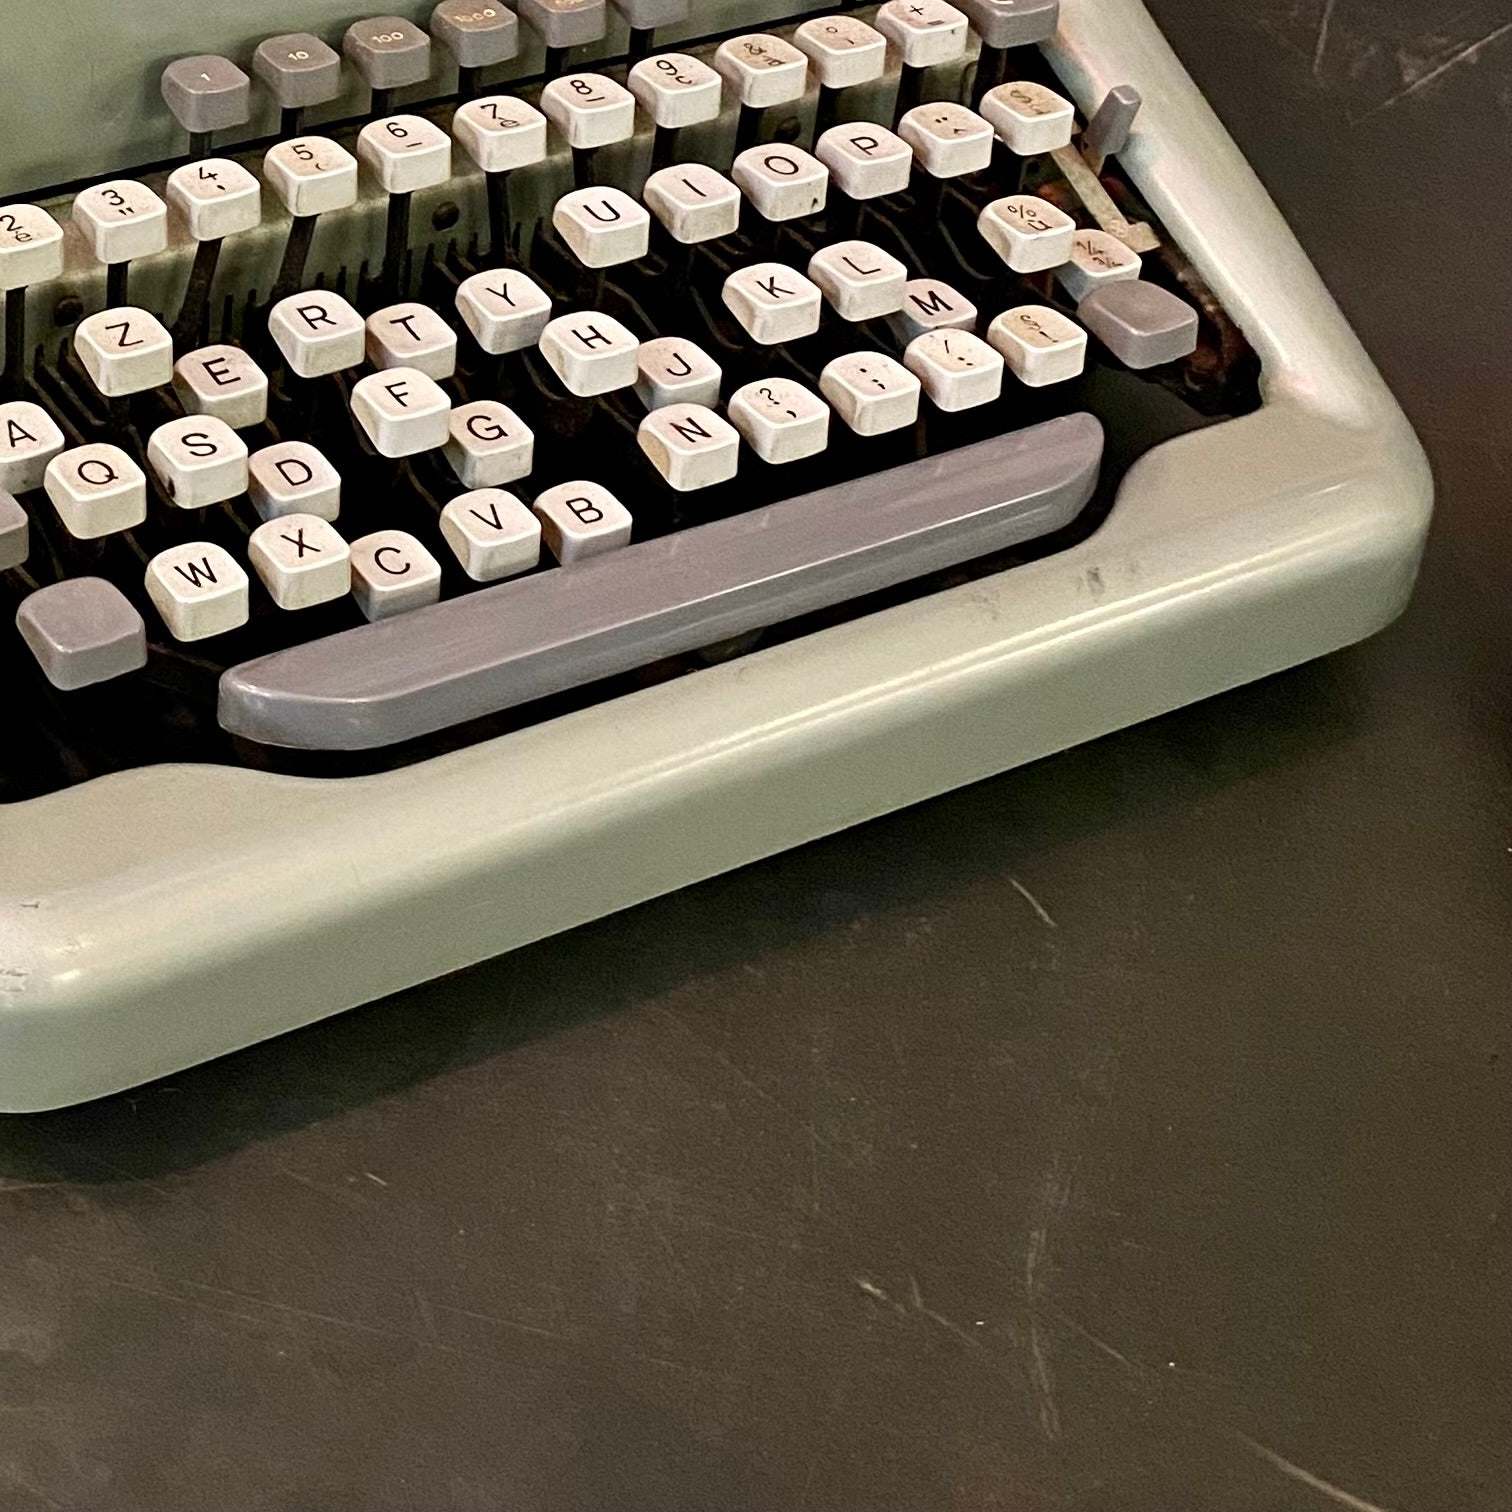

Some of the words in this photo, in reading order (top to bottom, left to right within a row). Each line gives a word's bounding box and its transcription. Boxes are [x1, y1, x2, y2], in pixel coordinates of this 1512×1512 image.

[454, 7, 497, 23] 1000
[371, 31, 404, 44] 100
[287, 50, 310, 62] 10
[655, 58, 678, 77] 9
[200, 72, 212, 82] 1
[569, 78, 593, 96] 8
[479, 102, 498, 120] 7
[385, 121, 409, 138] 6
[292, 143, 314, 162] 5
[848, 135, 879, 156] P
[198, 166, 219, 181] 4
[763, 154, 800, 176] O
[100, 188, 125, 208] 3
[681, 178, 708, 198] I
[582, 199, 622, 223] U
[1006, 203, 1038, 220] %
[841, 256, 882, 276] L
[484, 282, 517, 308] Y
[755, 275, 796, 300] K
[908, 289, 955, 317] M
[295, 304, 338, 331] R
[388, 314, 422, 342] T
[104, 321, 145, 348] Z
[570, 324, 614, 350] H
[201, 356, 242, 387] E
[665, 351, 693, 378] J
[383, 380, 410, 408] F
[759, 387, 781, 406] ?
[5, 418, 39, 449] A
[465, 414, 510, 442] G
[668, 416, 713, 444] N
[180, 431, 218, 458] S
[76, 458, 120, 486] Q
[274, 458, 314, 488] D
[468, 502, 504, 531] V
[564, 496, 605, 525] B
[279, 527, 322, 559] X
[173, 556, 219, 589] W
[373, 546, 412, 576] C
